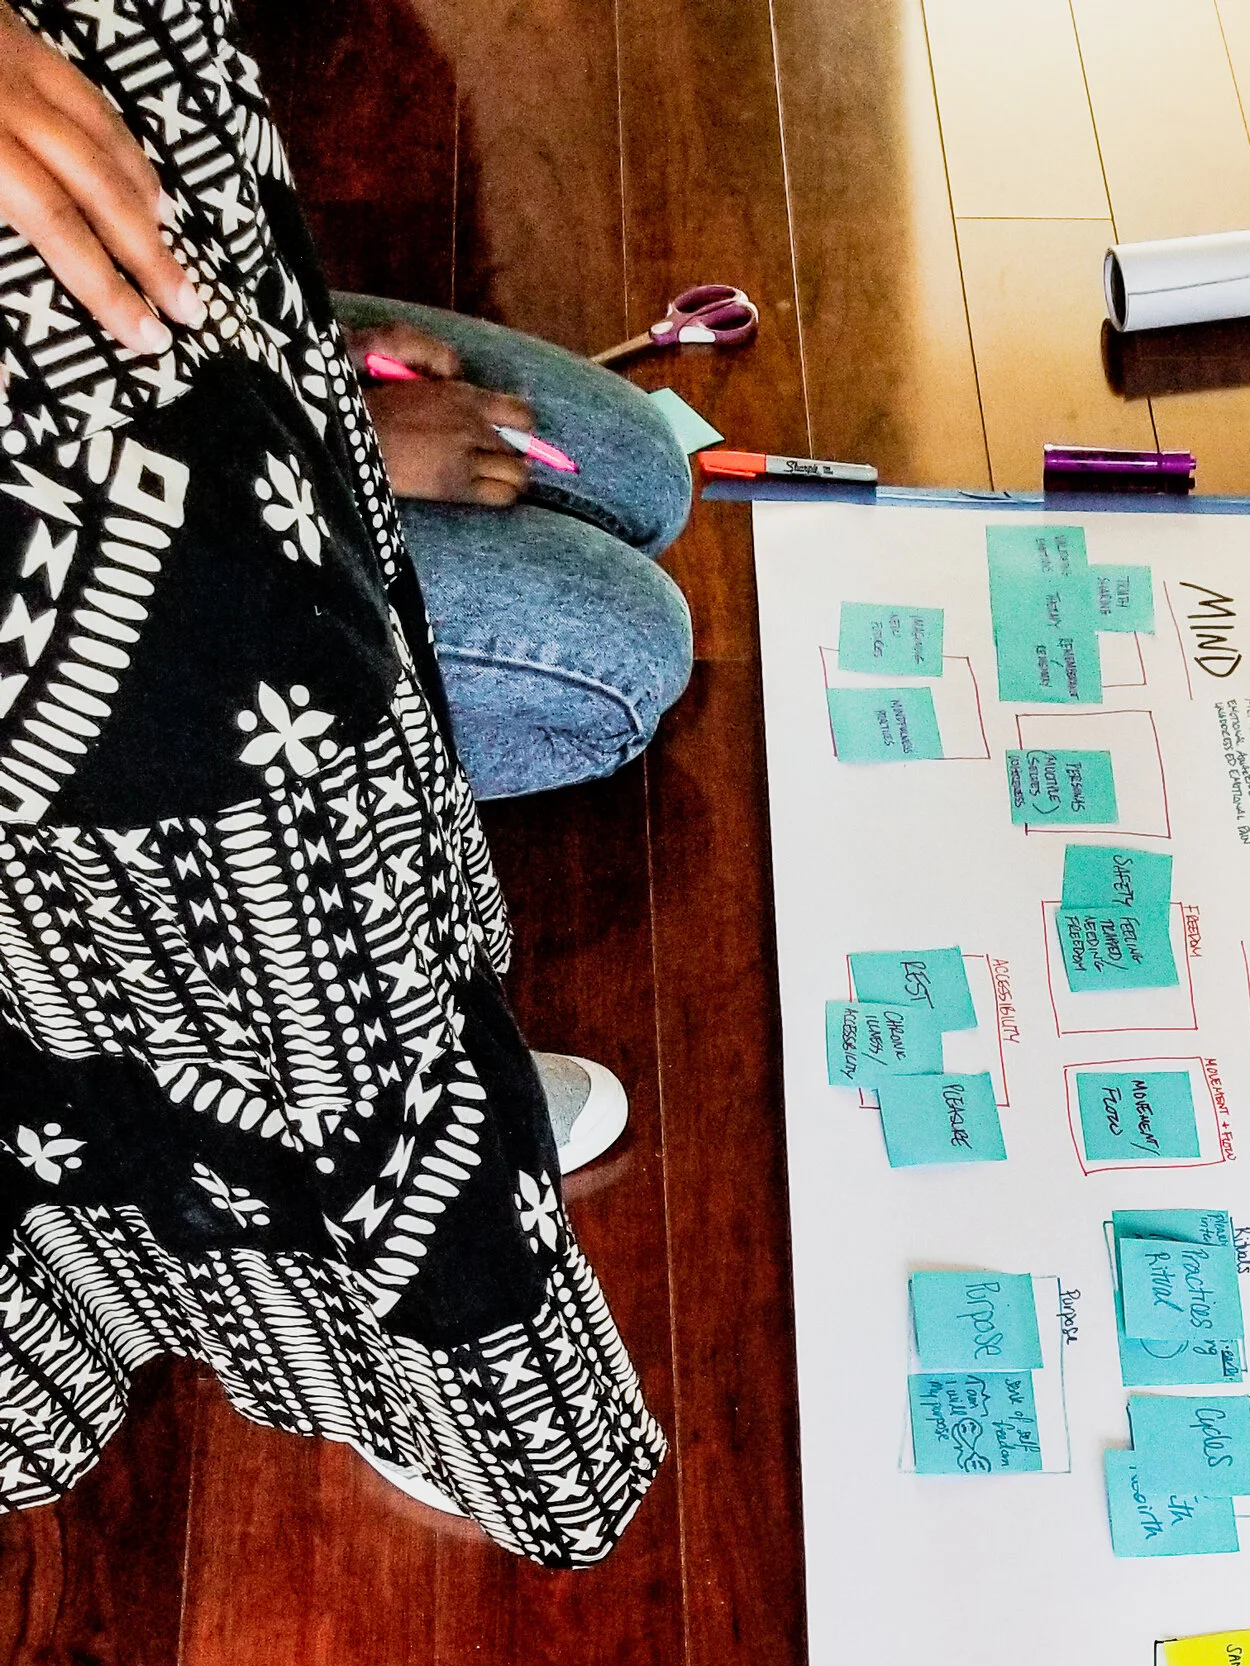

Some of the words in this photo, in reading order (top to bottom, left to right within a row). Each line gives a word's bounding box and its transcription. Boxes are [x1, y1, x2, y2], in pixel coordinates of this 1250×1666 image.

[1179, 582, 1241, 679] MIND
[889, 700, 912, 754] MINDFULNESS
[1226, 699, 1244, 746] EMOTIONAL
[1228, 769, 1244, 820] EMOTIONAL
[1236, 826, 1250, 845] PAIN
[1111, 855, 1133, 907] SAFETY
[1064, 915, 1086, 971] FREEDOM
[1083, 915, 1103, 972] NEEDING
[1119, 917, 1142, 964] FEELING
[1183, 905, 1201, 957] FREEDOM
[899, 960, 934, 1009] REST
[991, 958, 1019, 1044] ACCESSIBILITY
[883, 1011, 905, 1061] CHRONIC
[941, 1084, 971, 1150] PLEASURE
[1100, 1086, 1120, 1136] FLOW
[1204, 1058, 1229, 1115] MOVEMENT
[1220, 1131, 1235, 1161] FLOW
[1144, 1252, 1183, 1313] Ritual
[1180, 1249, 1215, 1329] Practices
[955, 1282, 1003, 1360] Purpose
[1055, 1289, 1080, 1346] Purpose
[919, 1402, 949, 1442] purpose
[945, 1390, 966, 1415] will
[1007, 1411, 1033, 1423] of
[991, 1420, 1015, 1467] freedom
[1012, 1430, 1040, 1453] self
[1193, 1408, 1233, 1469] Cycles
